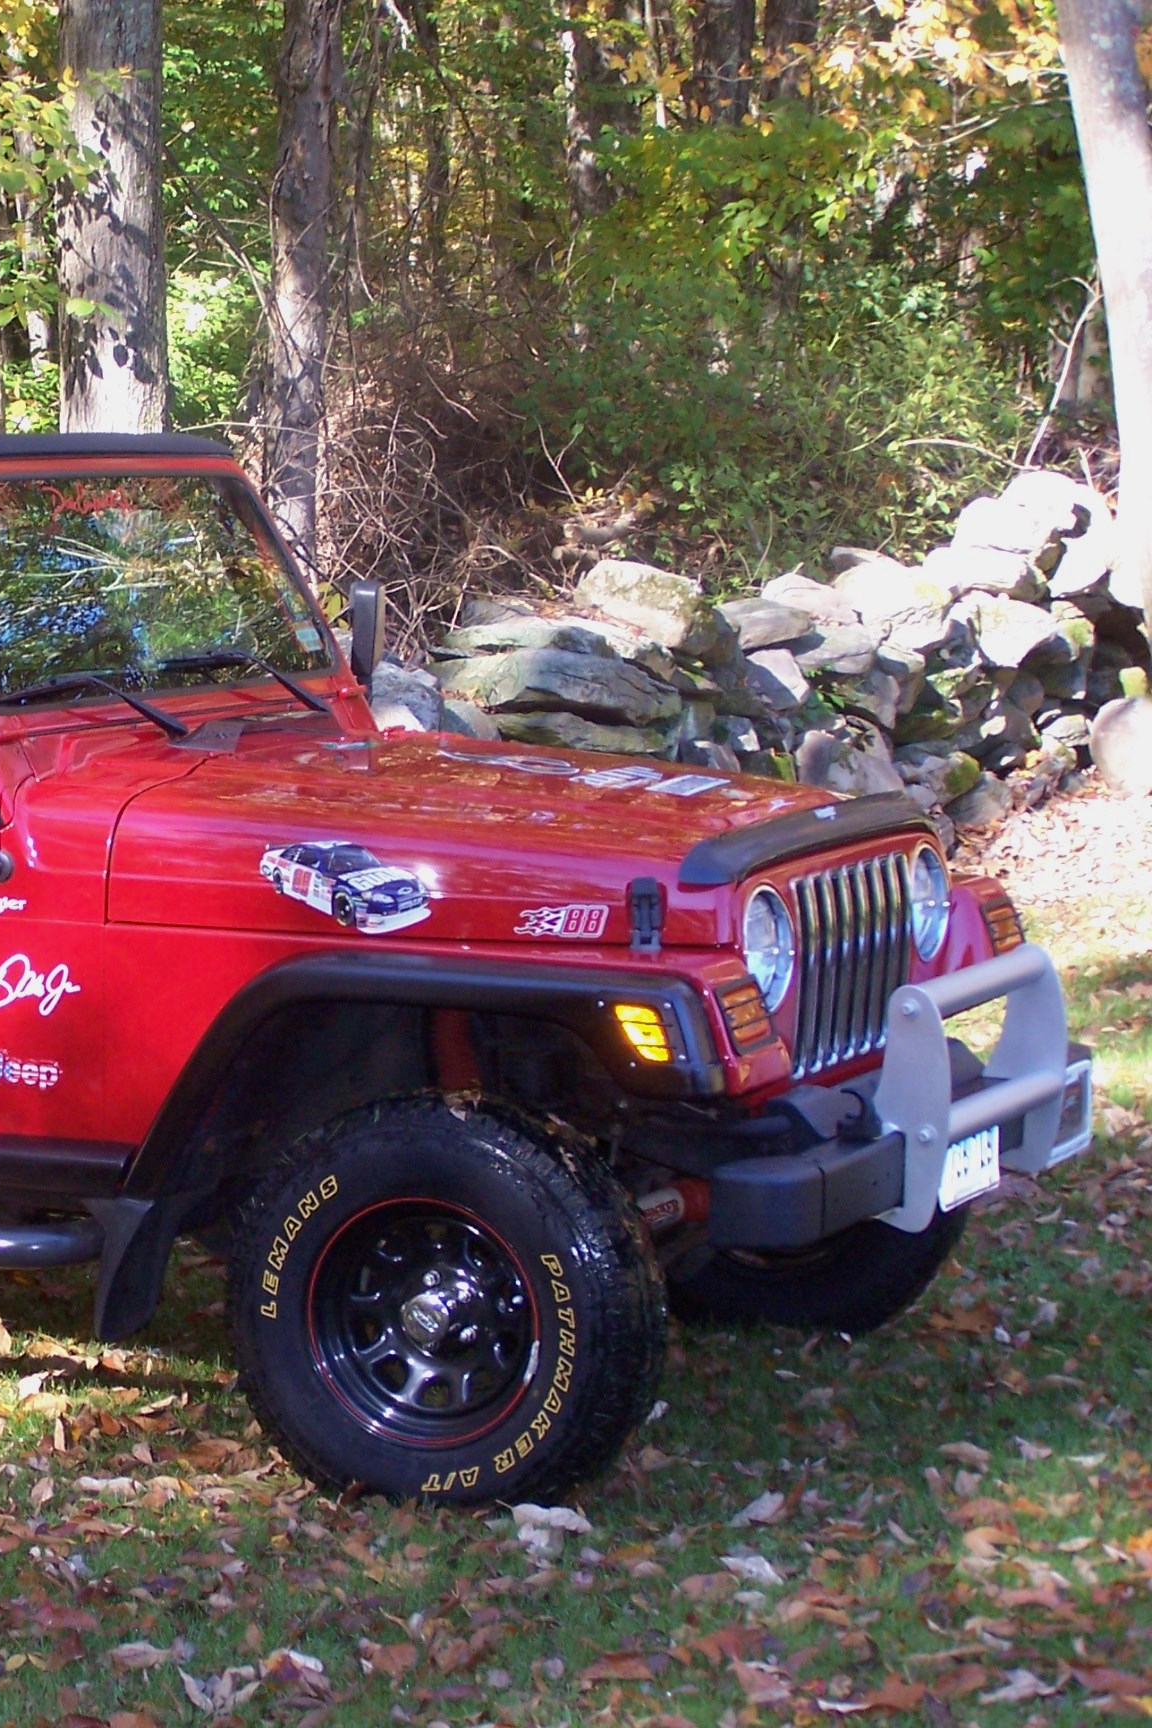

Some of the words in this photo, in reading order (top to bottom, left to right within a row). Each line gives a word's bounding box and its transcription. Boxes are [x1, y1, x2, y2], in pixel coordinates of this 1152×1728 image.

[559, 904, 609, 938] 88
[260, 1174, 339, 1319] LEMANS
[493, 1252, 576, 1474] PATHMAKER
